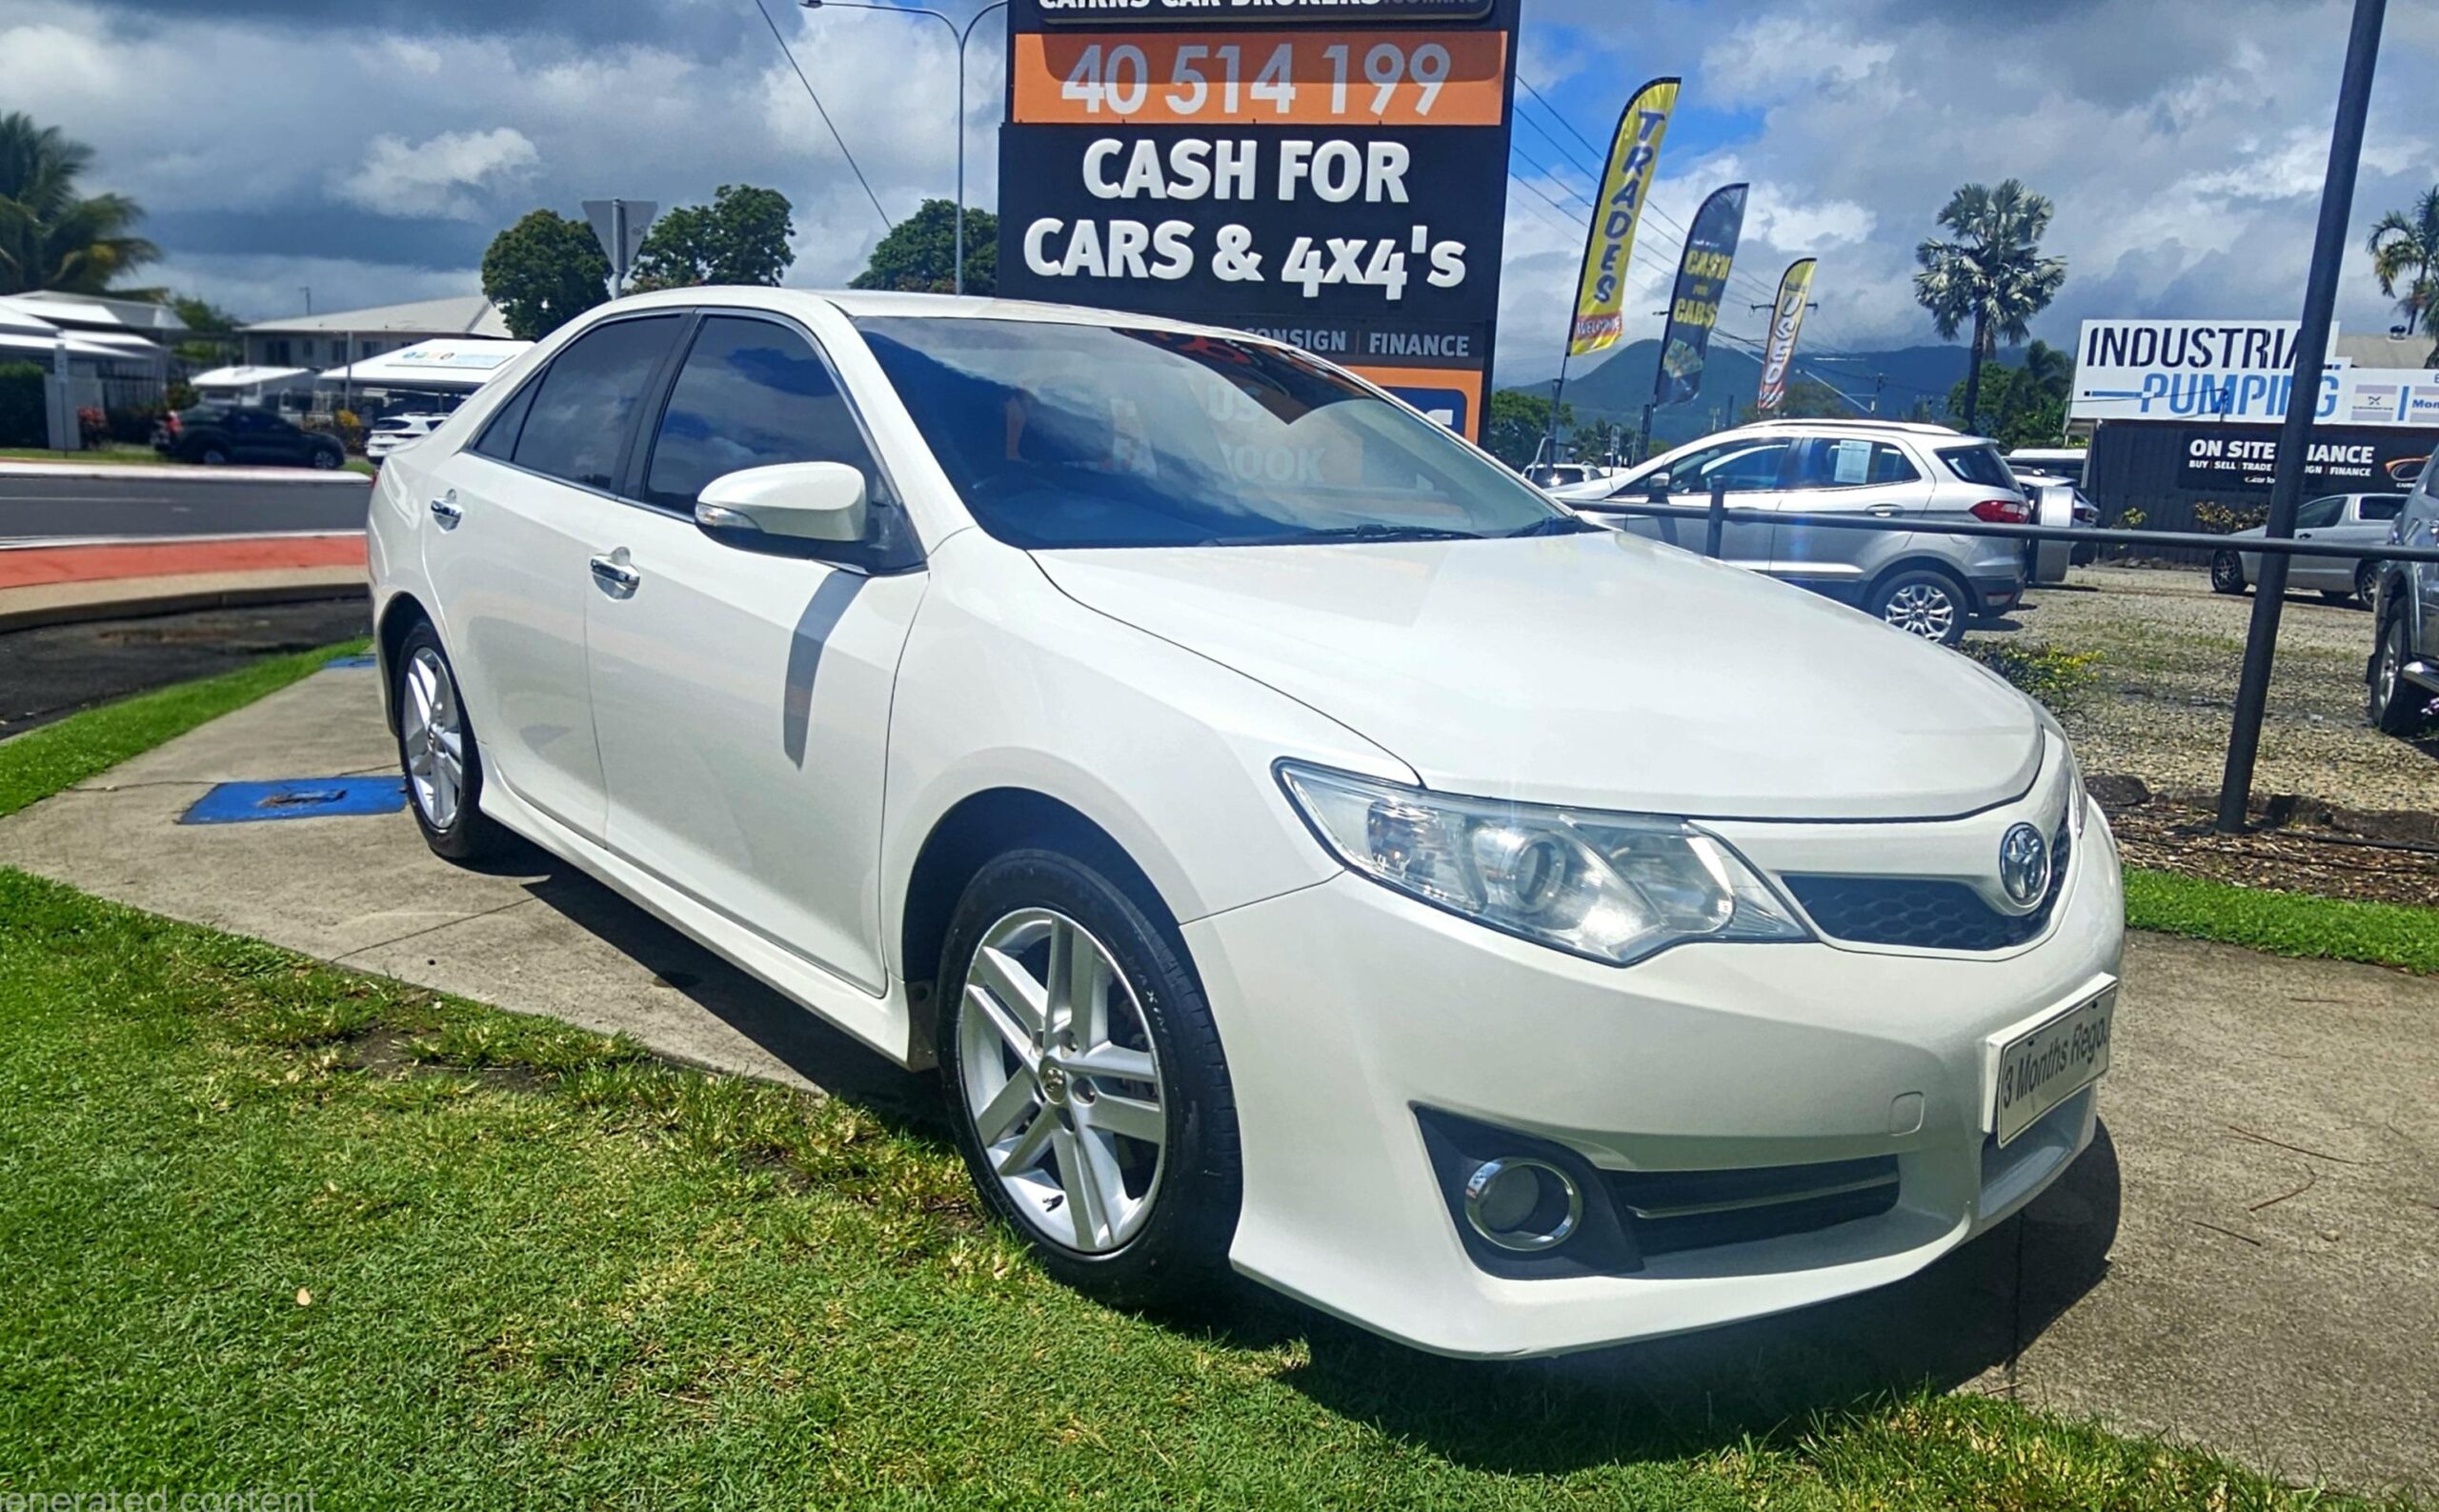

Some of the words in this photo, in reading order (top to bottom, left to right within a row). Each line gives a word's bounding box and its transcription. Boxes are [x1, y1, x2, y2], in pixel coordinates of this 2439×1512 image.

[1061, 44, 1148, 115] 40
[1165, 43, 1296, 114] 514
[1322, 43, 1452, 116] 199
[1082, 138, 1258, 201] CASH
[1278, 139, 1410, 203] FOR
[1594, 111, 1664, 303] TRADES
[1023, 217, 1195, 280] CARS
[1211, 223, 1265, 282] &
[1368, 333, 1469, 357] FINANCE
[2086, 327, 2332, 370] INDUSTRI
[2188, 459, 2208, 469] BUY
[2214, 461, 2236, 470] SELL
[2242, 462, 2272, 472] TRADE
[2329, 467, 2371, 476] FINANCE
[2189, 439, 2222, 457] ON
[2227, 441, 2277, 459] SITE
[2004, 1064, 2014, 1109] 3
[2016, 1035, 2068, 1102] Months
